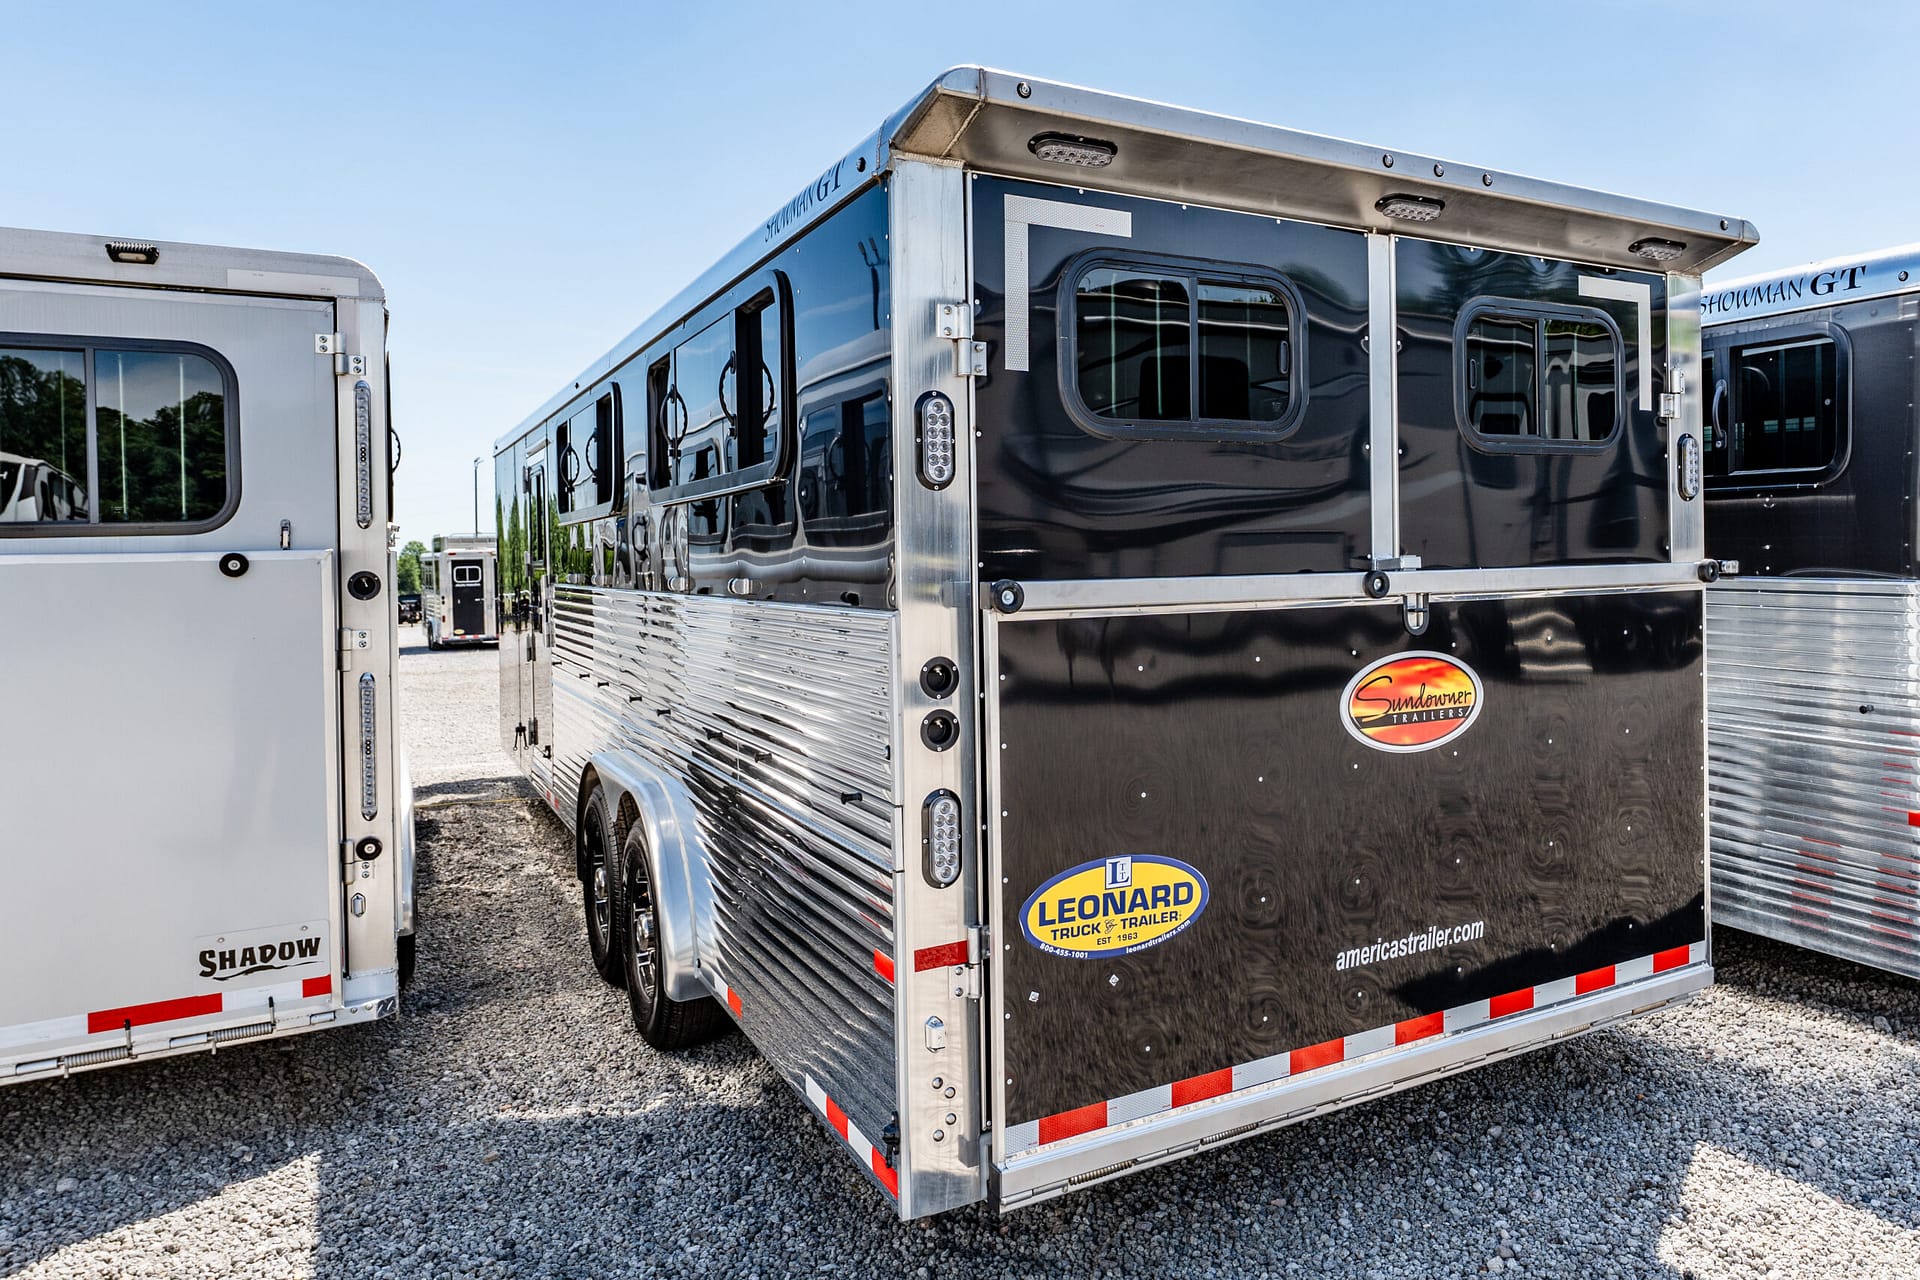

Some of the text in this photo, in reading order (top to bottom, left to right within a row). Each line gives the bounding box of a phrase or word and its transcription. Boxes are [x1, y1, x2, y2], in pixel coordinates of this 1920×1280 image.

[817, 155, 847, 202] GT
[1701, 265, 1867, 315] SHOWMAN GT
[1355, 675, 1472, 716] Sundowner
[1392, 707, 1464, 724] TRAILERS
[1039, 882, 1193, 926] LEONARD
[1051, 922, 1100, 940] TRUCK
[1121, 911, 1178, 929] TRAILER
[1097, 932, 1138, 946] EST 1963
[1126, 919, 1191, 954] leonardtrailers.com
[1336, 920, 1484, 971] americastrailer.com
[199, 937, 321, 977] SHADOW
[1039, 943, 1089, 959] 800-455-1001
